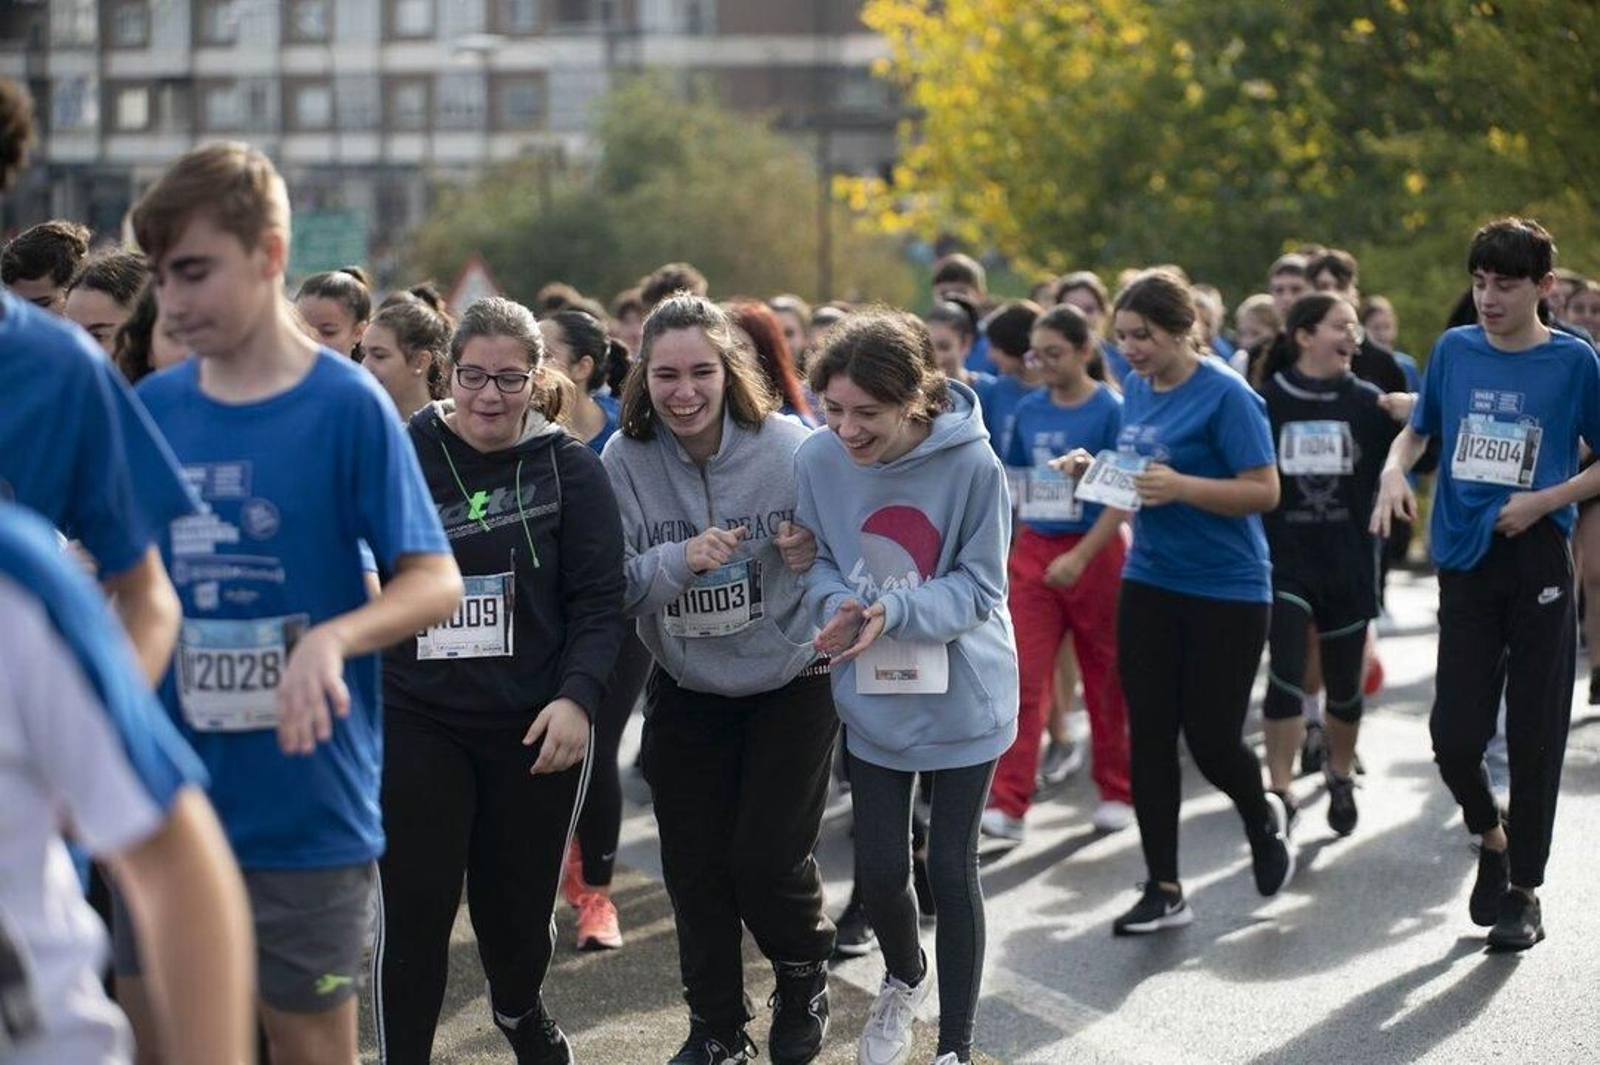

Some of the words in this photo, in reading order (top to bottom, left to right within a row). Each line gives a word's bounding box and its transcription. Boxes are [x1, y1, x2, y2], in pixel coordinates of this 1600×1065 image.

[1469, 436, 1522, 463] 12604
[433, 598, 497, 629] 009
[684, 583, 745, 614] 11003
